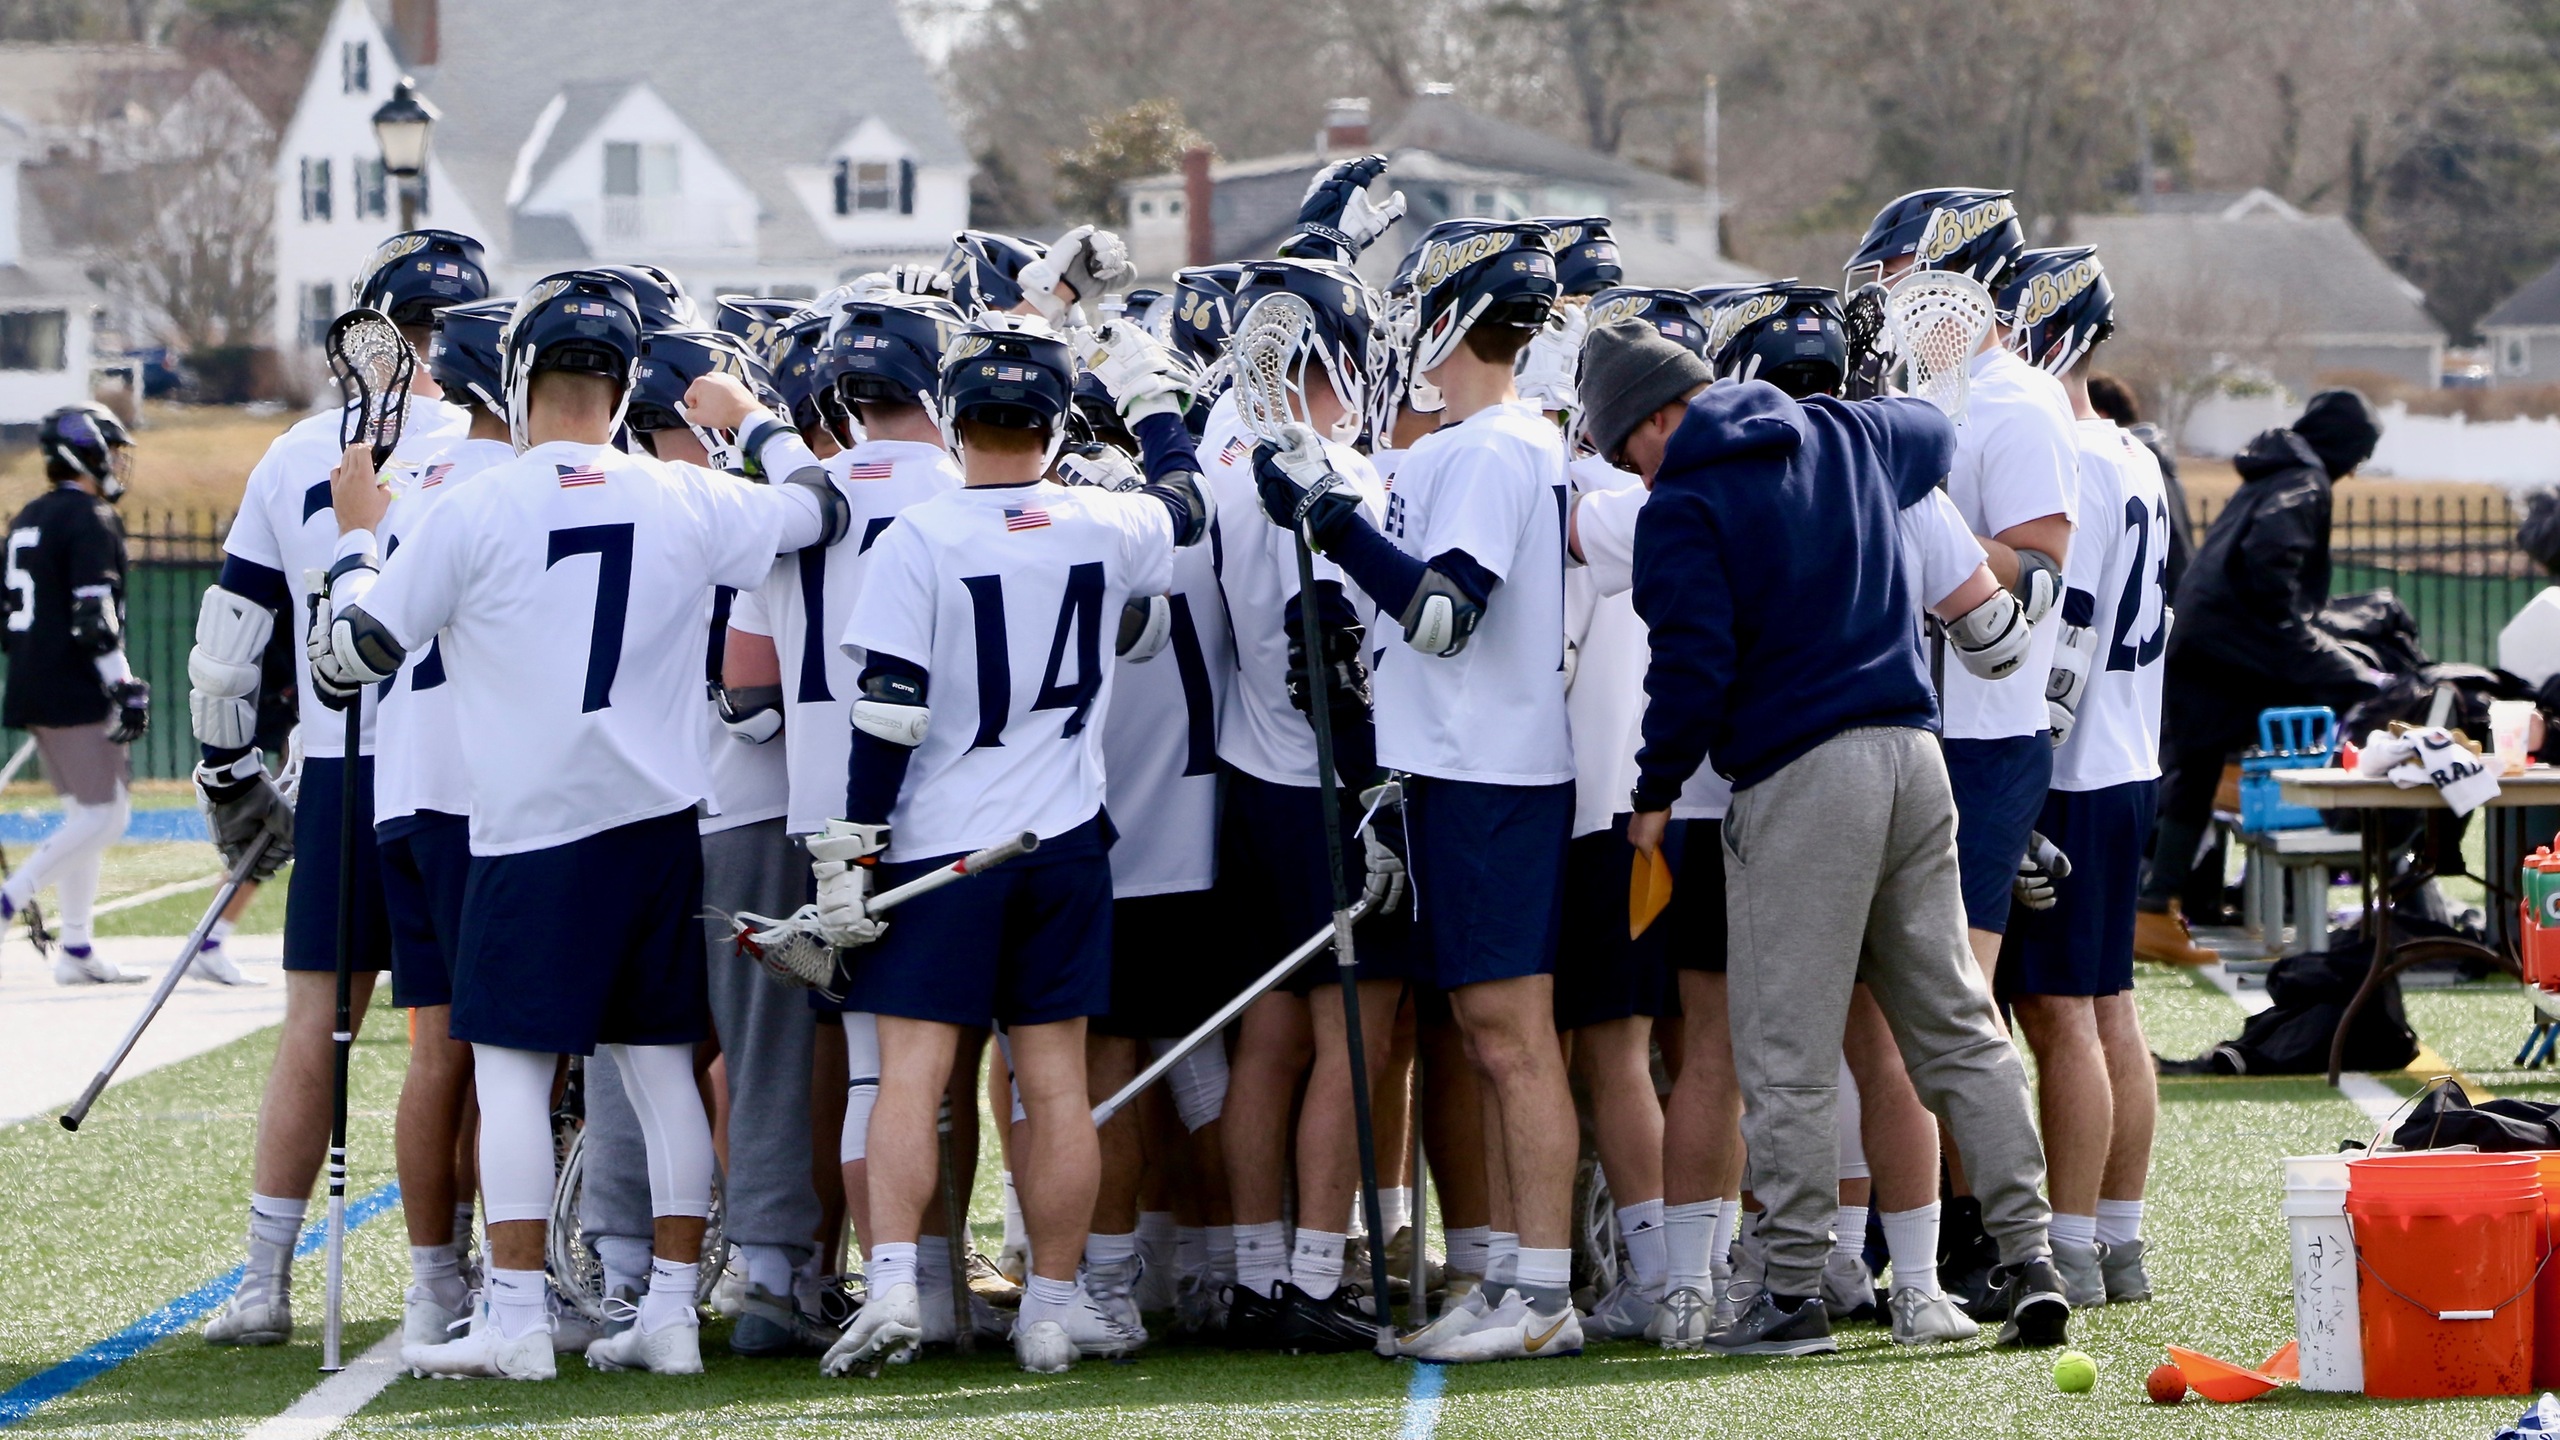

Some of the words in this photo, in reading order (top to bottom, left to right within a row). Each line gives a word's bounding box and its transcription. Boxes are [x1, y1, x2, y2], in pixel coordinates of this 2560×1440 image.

[417, 262, 432, 272] SC
[461, 271, 471, 281] RF
[1420, 232, 1514, 296] Bucs
[564, 304, 579, 314] SC
[2025, 255, 2104, 327] Bucs
[606, 309, 617, 318] RF
[1179, 291, 1214, 331] 36
[1773, 321, 1788, 332] SC
[982, 366, 996, 376] SC
[1025, 371, 1038, 381] RF
[5, 526, 41, 632] 5
[2105, 494, 2167, 672] 23
[545, 522, 635, 714] 7
[958, 561, 1105, 756] 14
[892, 682, 915, 694] ROME
[2308, 1236, 2324, 1337] TENNIS
[2330, 1286, 2346, 1322] LAX
